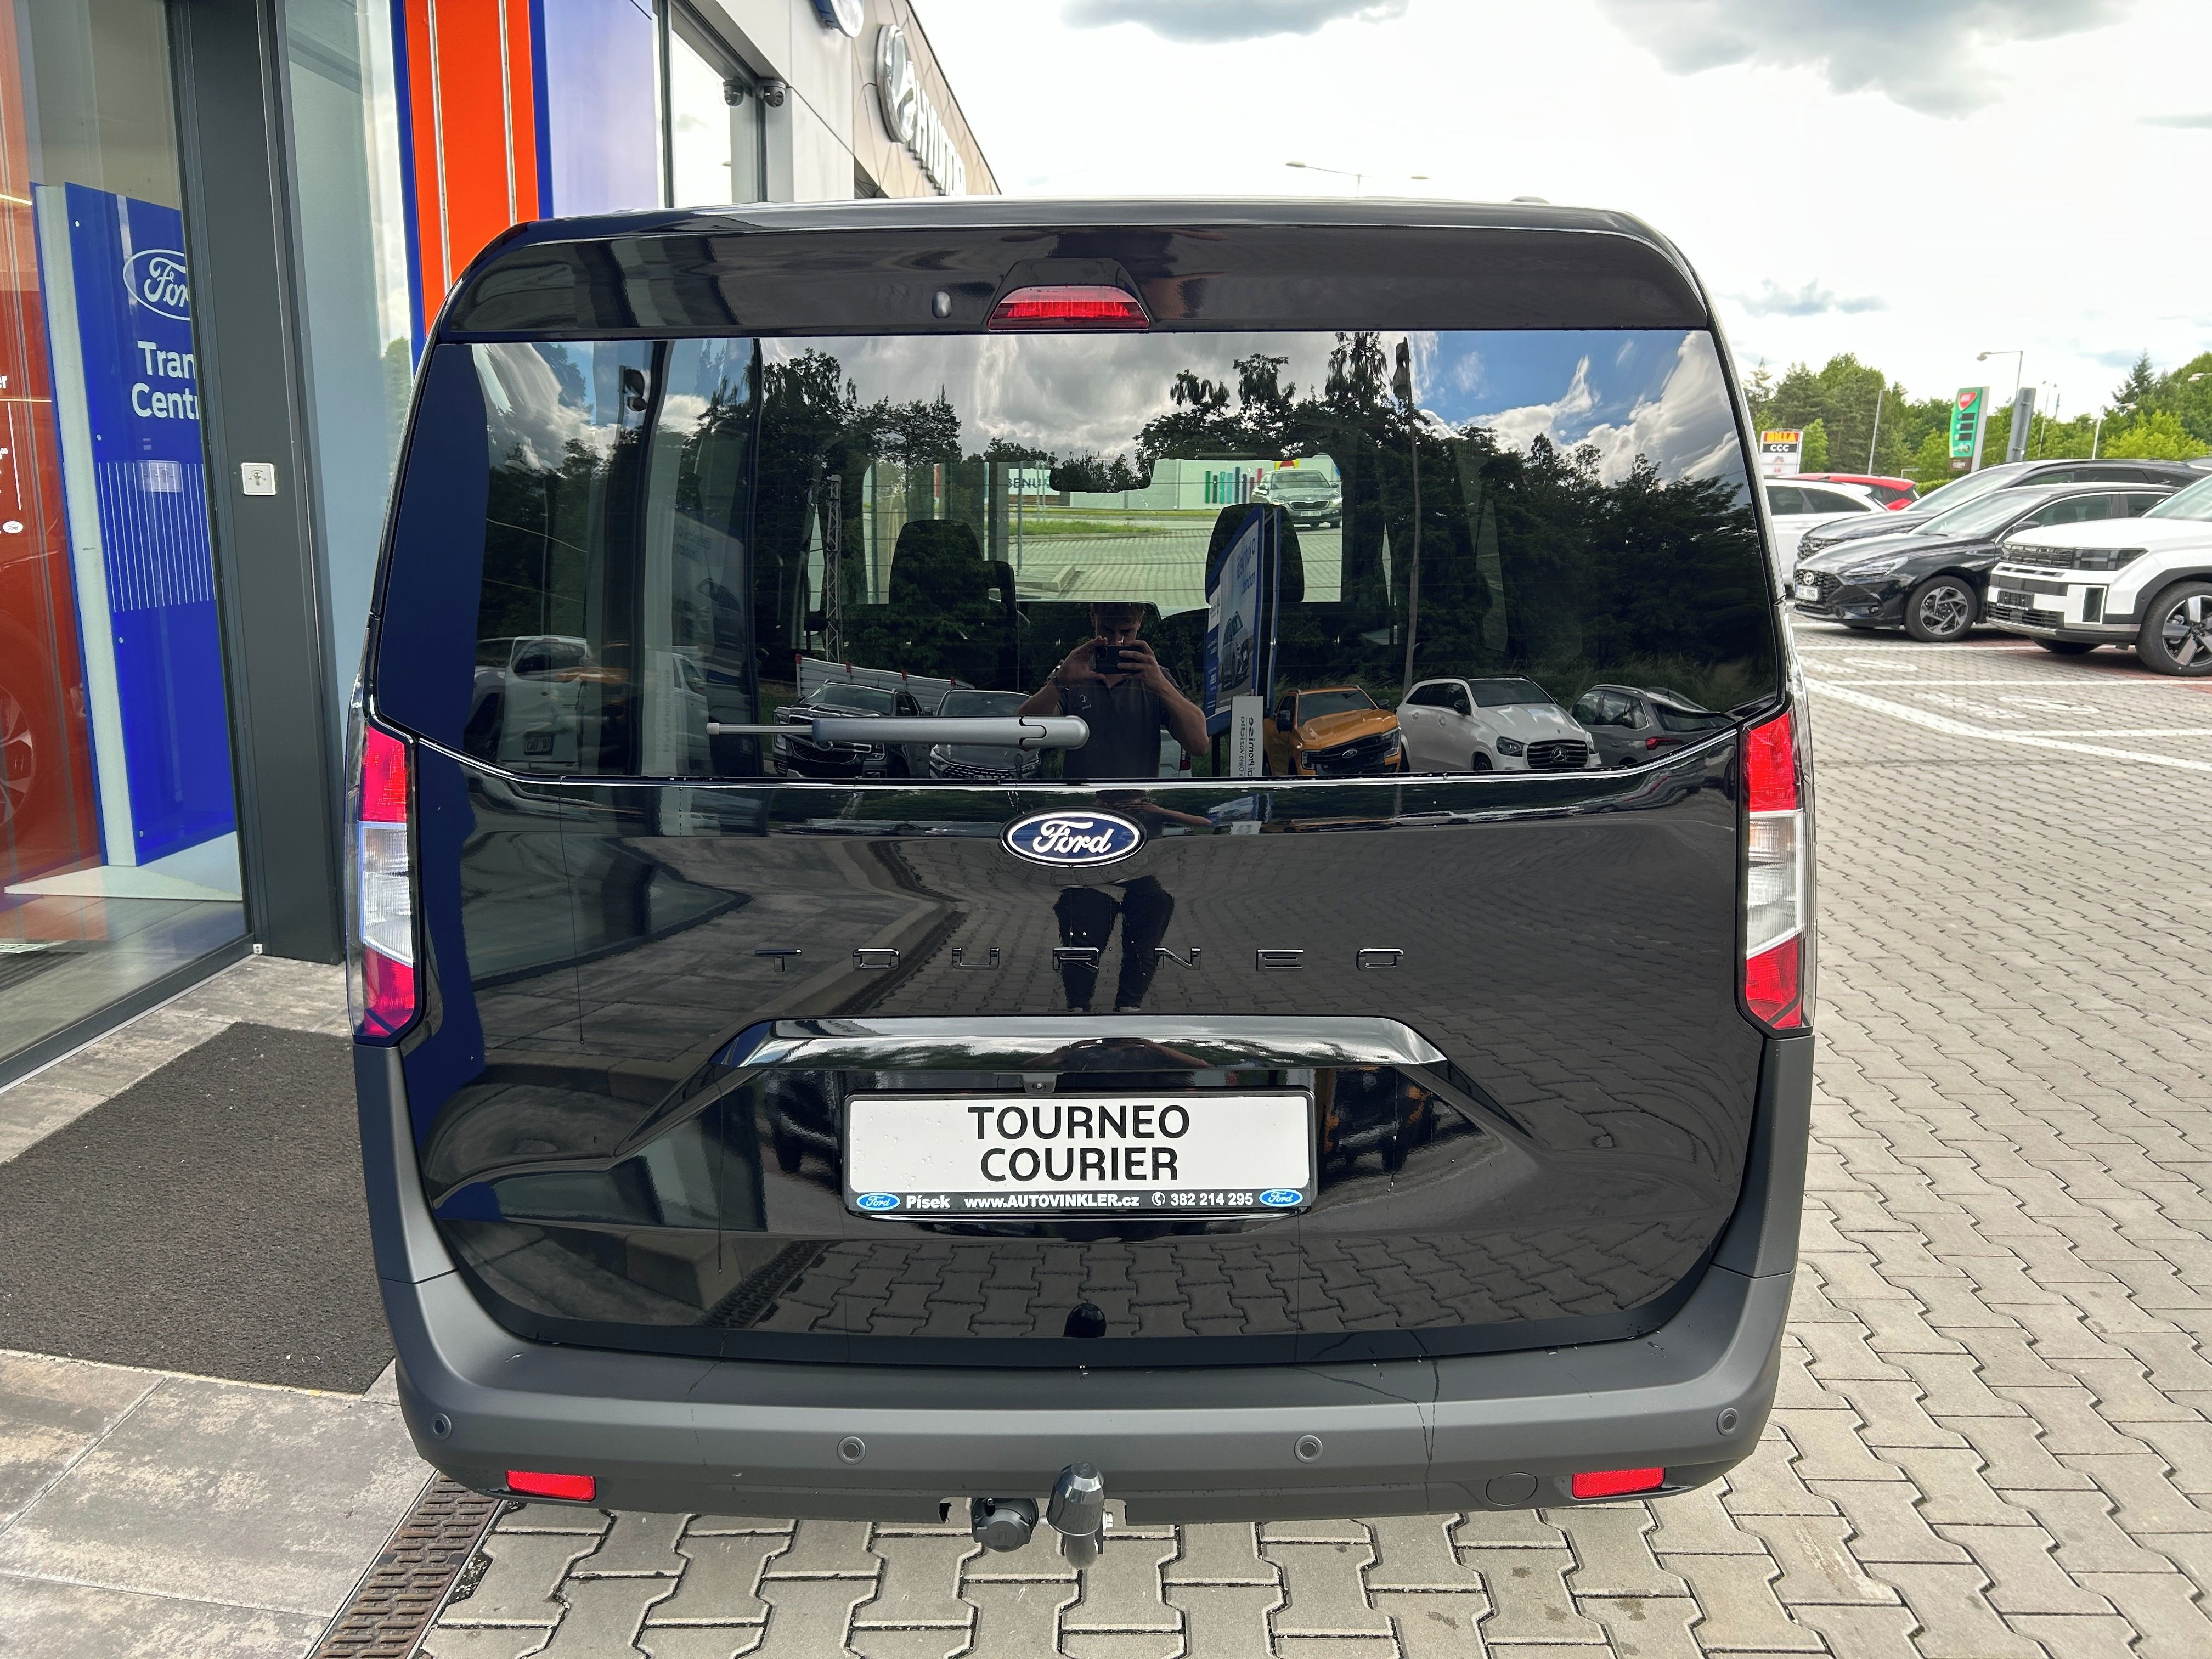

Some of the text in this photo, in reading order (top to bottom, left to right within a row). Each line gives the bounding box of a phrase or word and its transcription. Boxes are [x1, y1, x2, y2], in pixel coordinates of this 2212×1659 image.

[144, 257, 189, 307] For
[137, 340, 196, 379] Tran
[1032, 820, 1114, 853] Ford
[755, 947, 1404, 972] TOURNEO
[968, 1105, 1189, 1139] TOURNEO
[980, 1147, 1177, 1182] COURIER
[906, 1195, 951, 1209] Písek
[964, 1193, 1140, 1208] www.AUTOVINKLER.cz
[1170, 1193, 1196, 1206] 382
[1199, 1193, 1224, 1206] 214
[1228, 1192, 1254, 1205] 295
